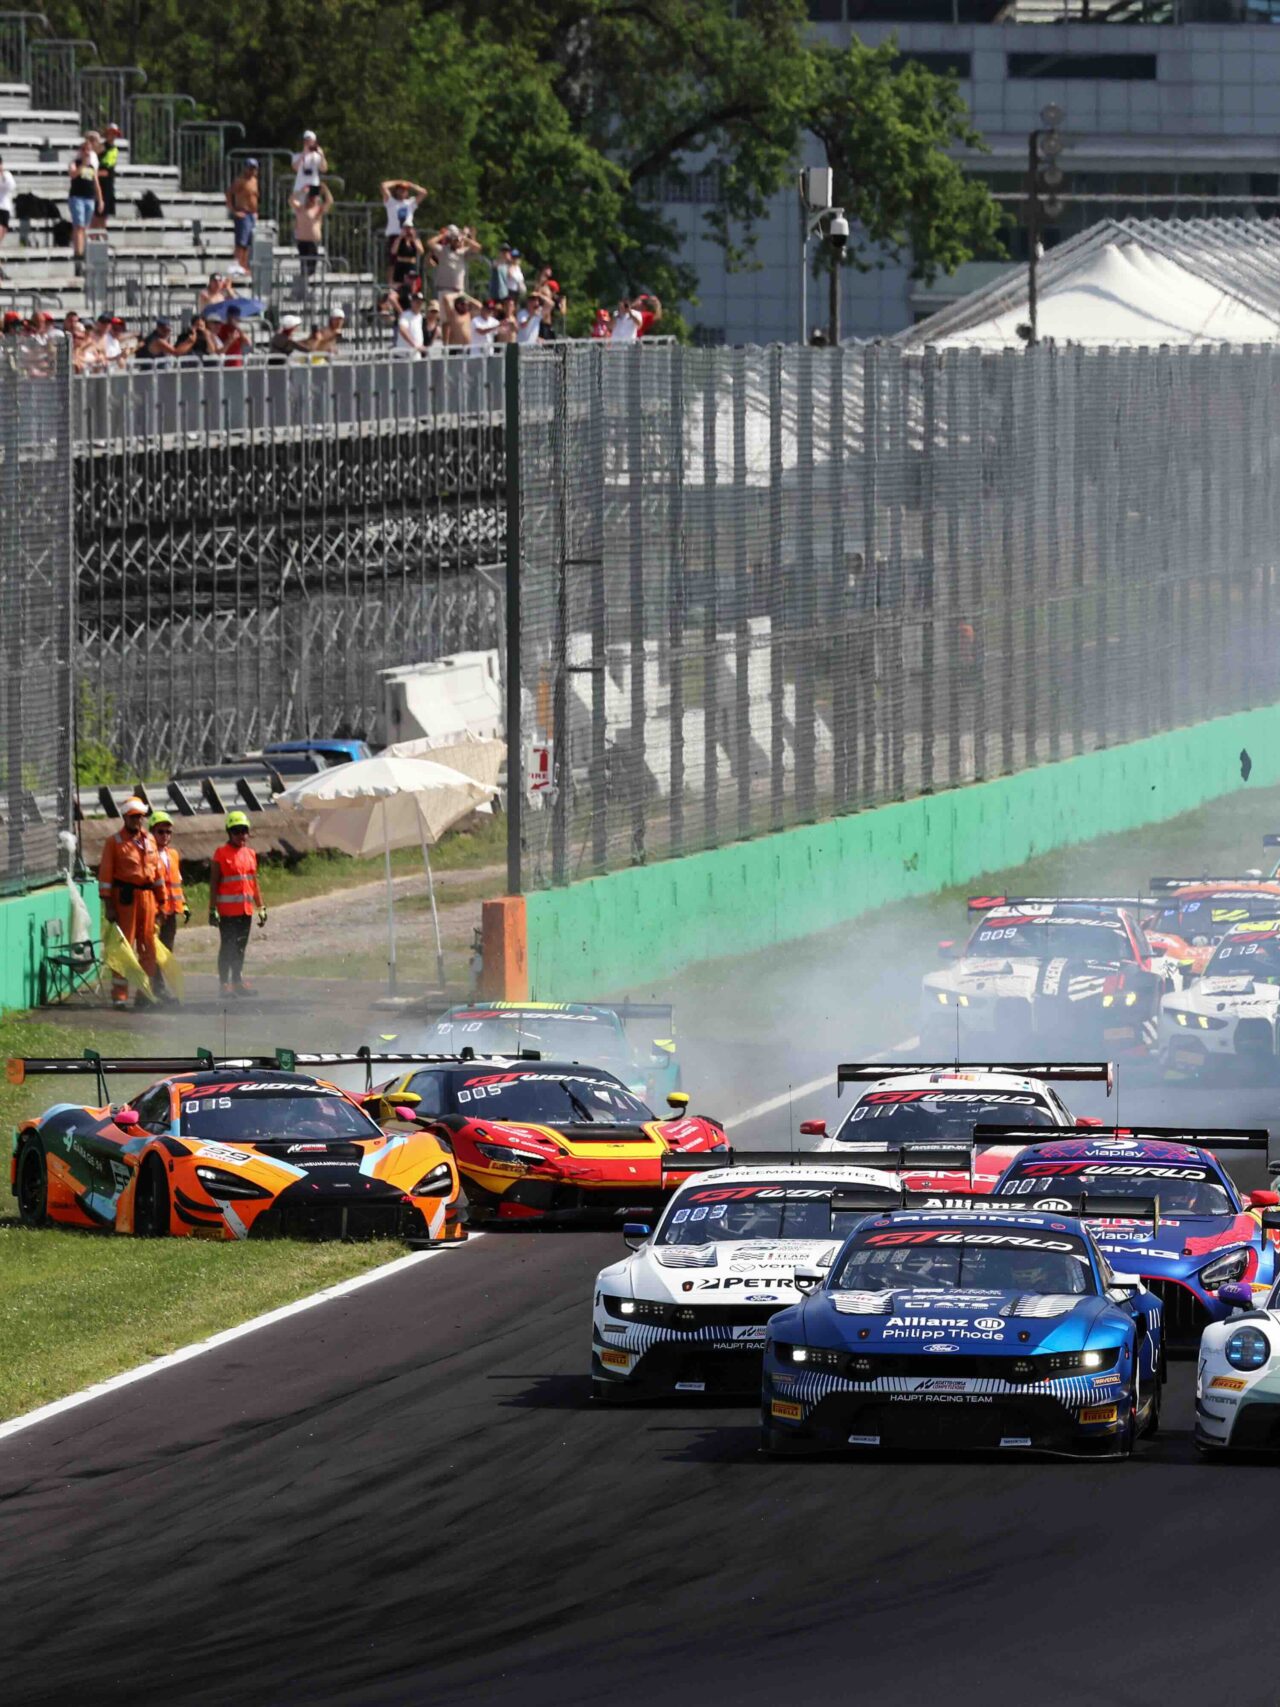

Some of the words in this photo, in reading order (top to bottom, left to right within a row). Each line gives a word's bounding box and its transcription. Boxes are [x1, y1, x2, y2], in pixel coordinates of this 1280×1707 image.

[1085, 1149, 1146, 1158] viaplay
[925, 1198, 1026, 1210] Allianz
[723, 1277, 819, 1289] PETRO
[886, 1317, 969, 1328] Allianz
[882, 1328, 945, 1340] Philipp
[948, 1329, 1005, 1341] Thode
[1212, 1376, 1245, 1390] PIRELLI
[925, 1394, 964, 1402] RACING
[966, 1395, 993, 1403] TEAM
[773, 1403, 800, 1417] PIRELLI
[1082, 1407, 1115, 1422] PIRELLI
